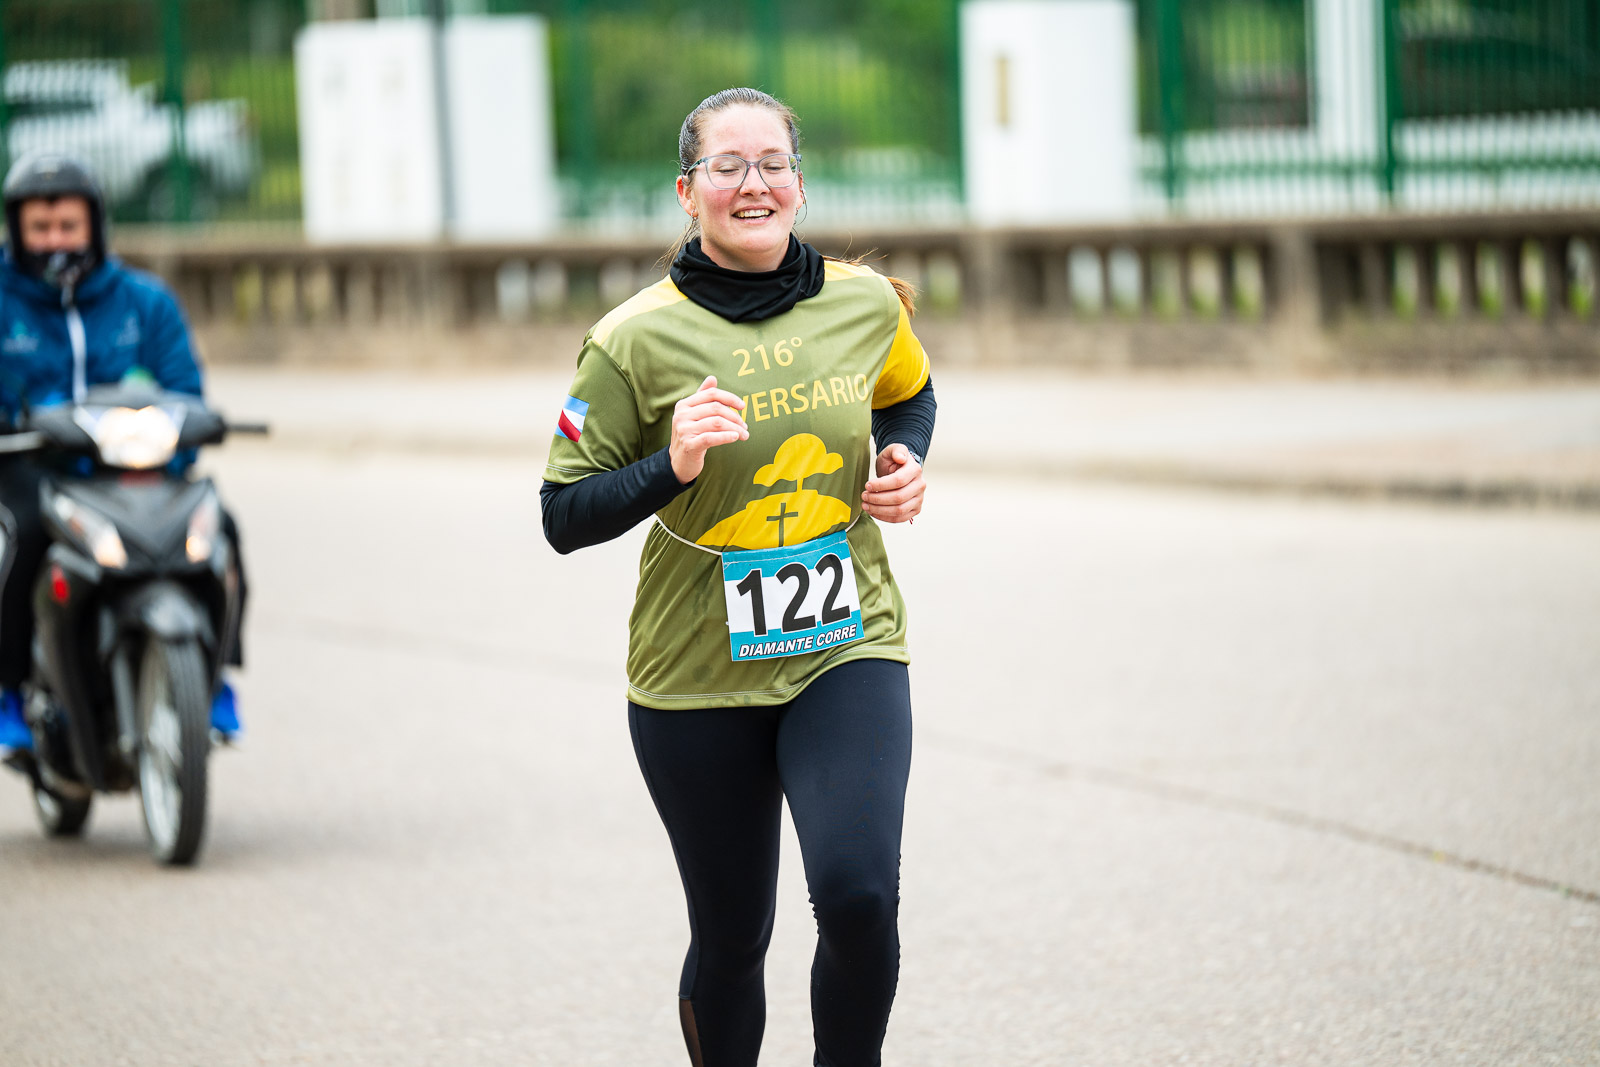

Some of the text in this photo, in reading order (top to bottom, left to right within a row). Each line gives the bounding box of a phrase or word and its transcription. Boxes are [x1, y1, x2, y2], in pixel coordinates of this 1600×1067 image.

[736, 553, 851, 636] 122
[738, 624, 857, 658] DIAMANTE CORRE
